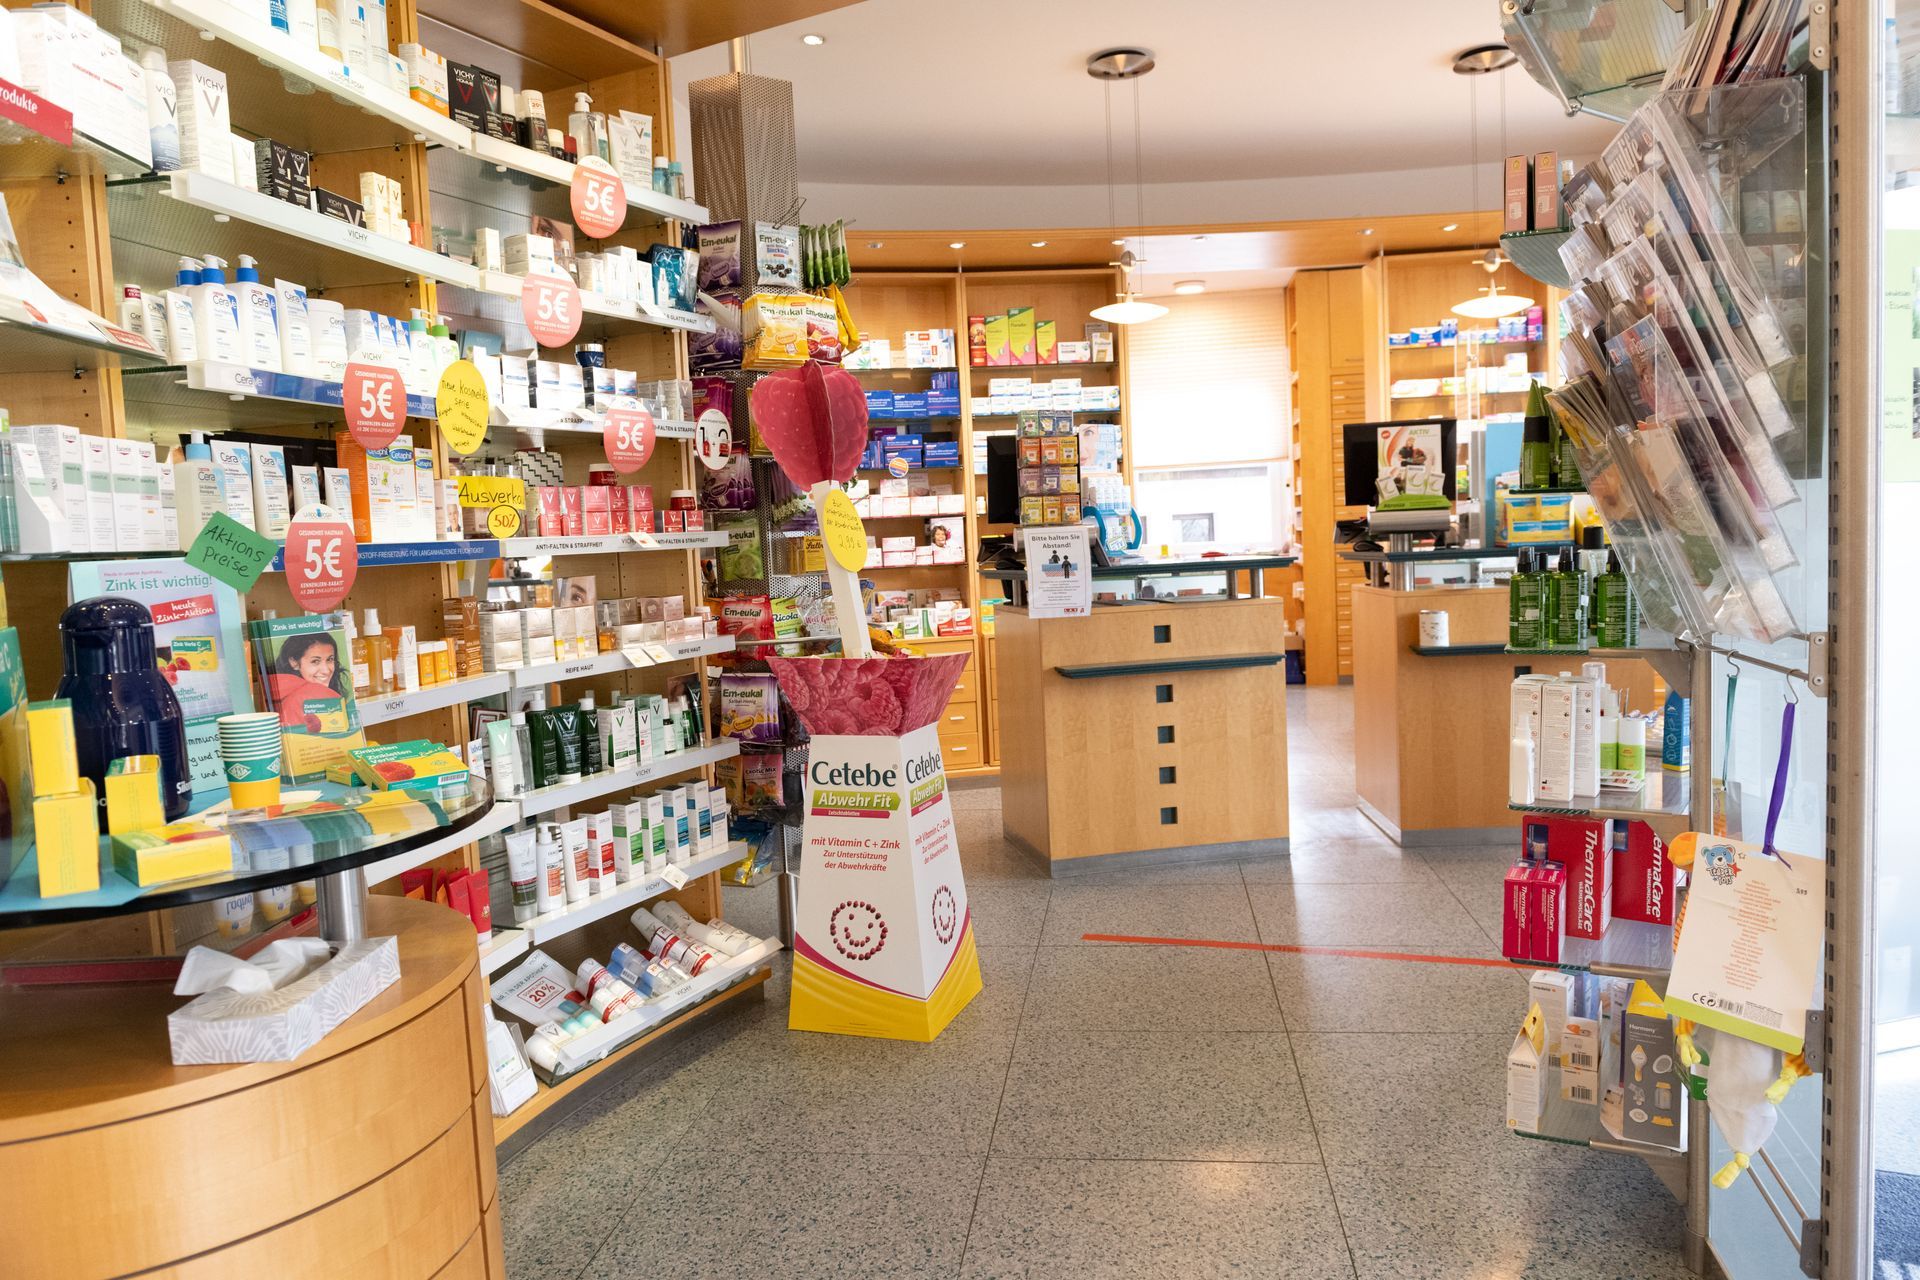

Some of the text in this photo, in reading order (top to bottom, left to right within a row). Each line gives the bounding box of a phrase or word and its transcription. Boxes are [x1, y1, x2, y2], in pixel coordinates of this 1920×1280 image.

[453, 67, 475, 81] VICHY
[480, 74, 498, 84] VICHY
[195, 73, 225, 92] VICHY
[273, 145, 287, 154] VICHY
[290, 152, 306, 162] VICHY
[584, 179, 616, 217] 5€
[348, 229, 368, 242] VICHY
[701, 235, 737, 248] Em-eukal
[537, 287, 571, 324] 5€
[806, 308, 836, 321] Em-eukal
[360, 379, 395, 420] 5€
[616, 420, 645, 453] 5€
[391, 450, 413, 461] Cetaphil
[416, 460, 433, 468] Cetaphil
[494, 513, 516, 529] 50%
[205, 524, 266, 563] Aktions
[574, 541, 603, 549] STRAFFHEIT
[202, 546, 250, 578] preise
[303, 537, 344, 580] 5€
[105, 575, 213, 592] Zink ist wichtig!
[170, 600, 197, 611] heute
[724, 607, 762, 617] Em-eukal
[156, 607, 214, 624] Zink-Aktion
[773, 612, 799, 622] Ricola
[272, 621, 322, 632] Zink ist wichtig!
[565, 664, 594, 674] REIFE HAUT
[722, 689, 763, 698] Em-eukal
[384, 700, 405, 710] VICHY
[199, 753, 213, 762] und
[367, 749, 413, 761] Zinkletten
[201, 770, 218, 779] und
[635, 768, 651, 777] VICHY
[905, 751, 941, 785] Cetebe
[912, 778, 943, 805] Abwehr Fit
[818, 792, 892, 808] Abwehr Fit
[810, 836, 827, 846] mit
[827, 837, 862, 848] Vitamin
[863, 839, 871, 848] C
[879, 839, 901, 849] Zink
[823, 849, 888, 862] Zur Unterstützung
[824, 861, 887, 872] der Abwehrkräfte
[645, 881, 661, 892] VICHY
[1584, 829, 1598, 935] ThermaCare
[1520, 885, 1528, 929] ThermaCare
[529, 982, 556, 1003] 20%
[675, 985, 692, 997] VICHY
[1629, 1023, 1656, 1034] Harmony
